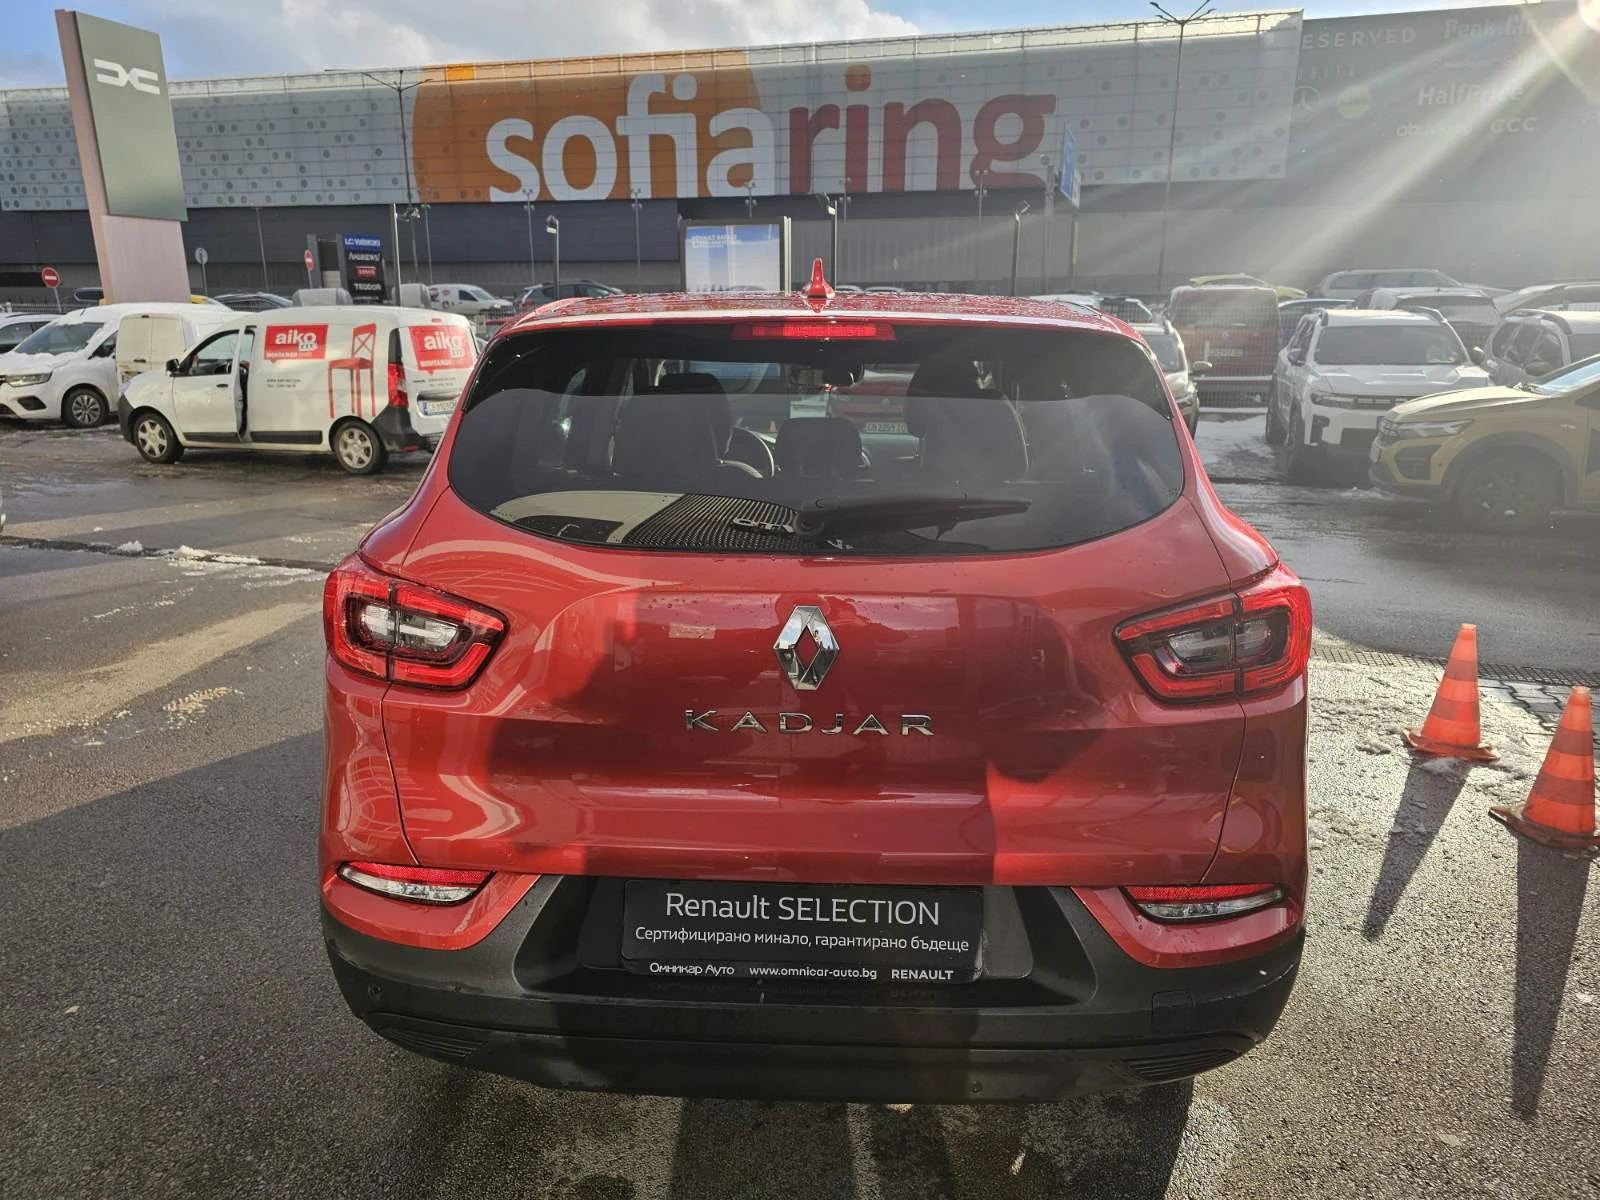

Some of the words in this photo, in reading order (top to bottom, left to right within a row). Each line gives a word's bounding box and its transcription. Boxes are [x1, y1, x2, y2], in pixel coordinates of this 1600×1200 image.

[1302, 28, 1415, 49] ESERVED
[275, 329, 317, 345] aiko
[685, 709, 935, 736] KADJAR
[665, 892, 770, 921] Renault
[778, 896, 940, 926] SELECTION
[635, 926, 751, 945] Сертифицирано
[754, 932, 812, 947] минало,
[815, 936, 907, 950] гарантирано
[910, 935, 969, 952] бъдеще
[649, 962, 703, 976] Омникар
[705, 964, 735, 977] Ауто
[749, 966, 878, 980] www.omnicar-auto.bg
[891, 968, 954, 980] RENAULT
